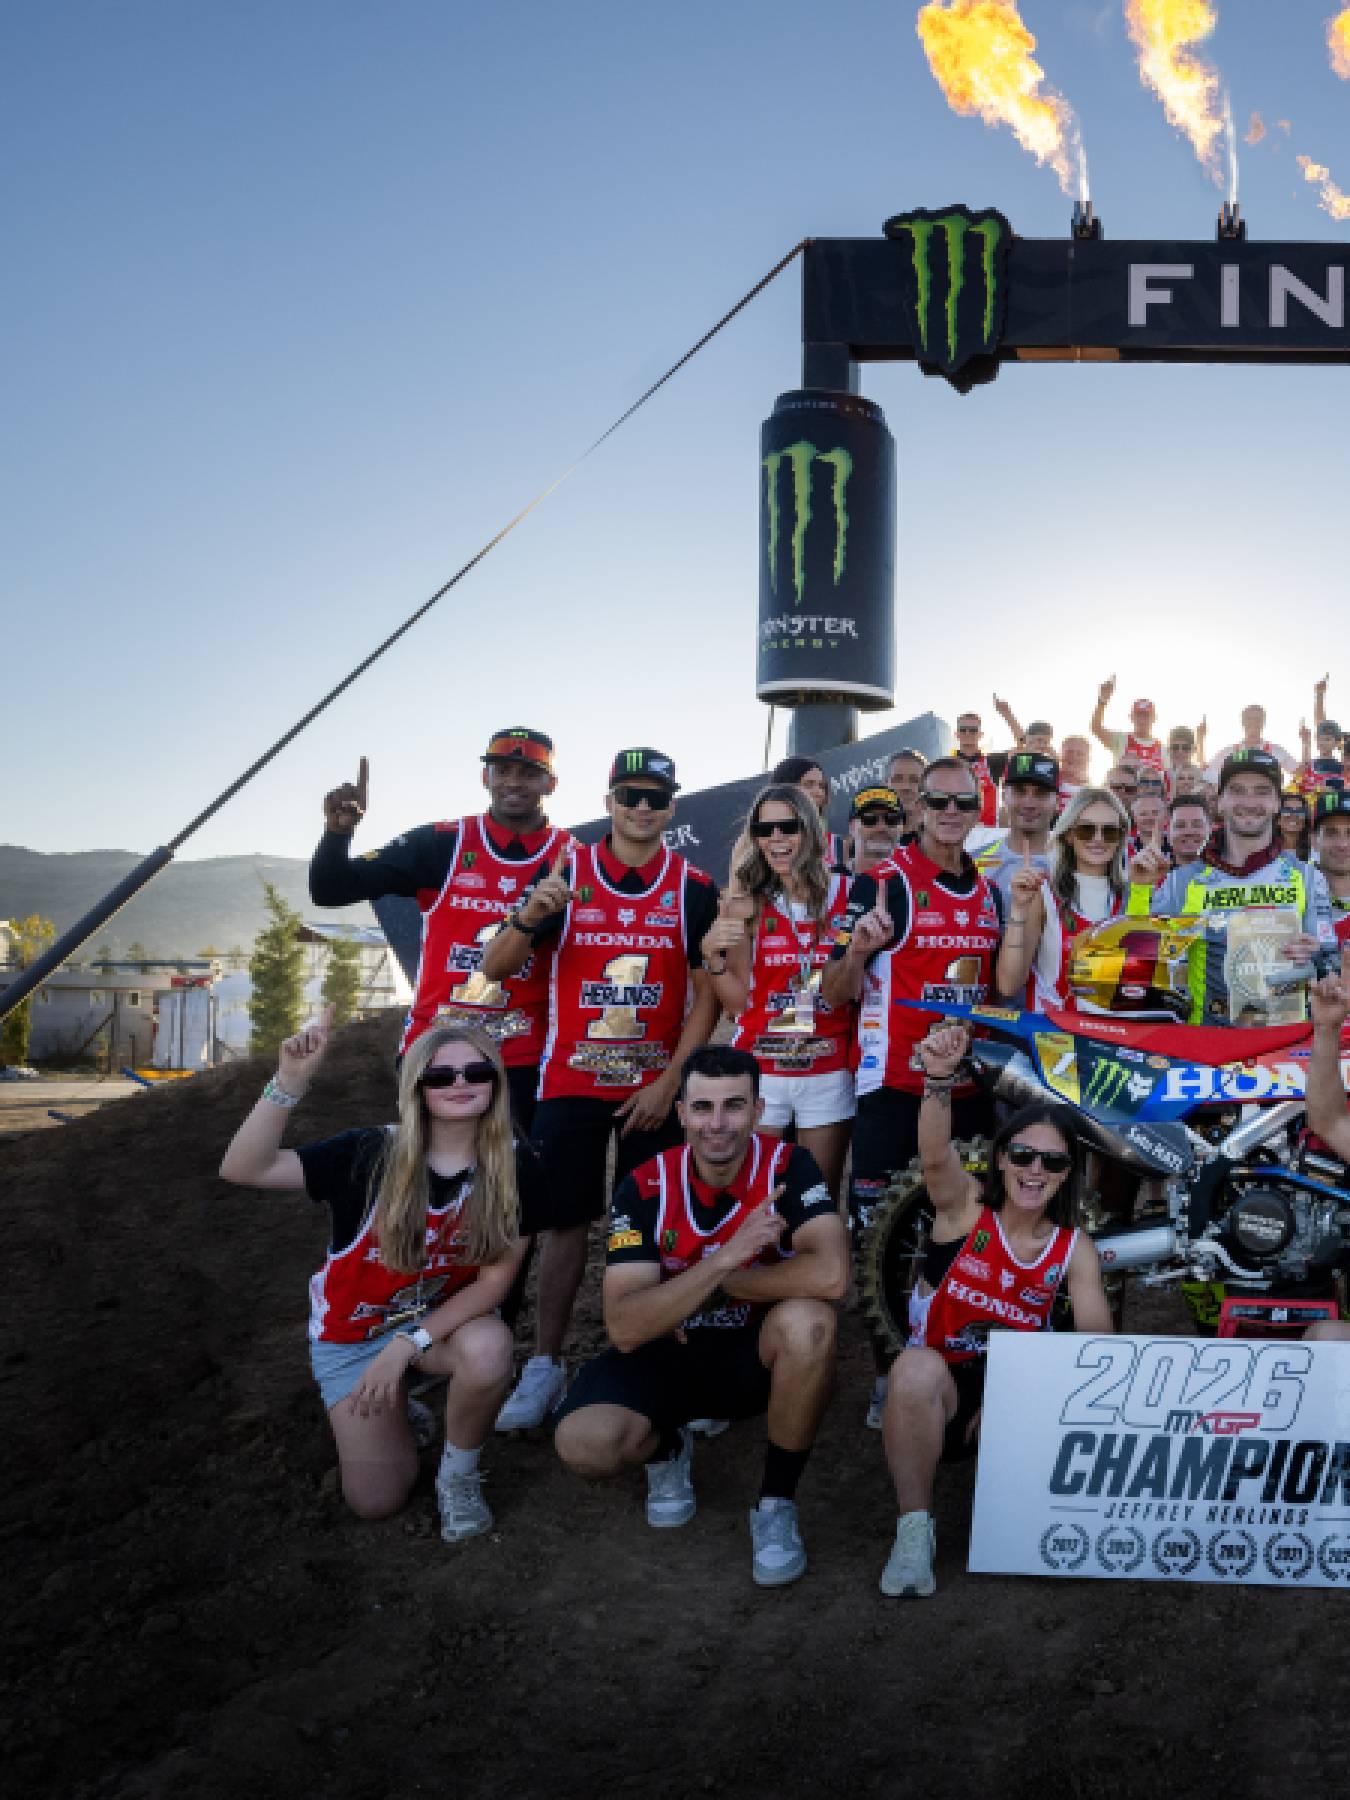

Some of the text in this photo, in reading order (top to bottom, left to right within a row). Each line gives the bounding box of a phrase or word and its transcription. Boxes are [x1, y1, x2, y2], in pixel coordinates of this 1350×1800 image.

[829, 755, 889, 794] MONST
[1202, 885, 1298, 910] HERLINGS
[574, 932, 675, 949] HONDA
[581, 983, 662, 1006] HERLINGS
[947, 1279, 1042, 1327] HONDA
[1058, 1337, 1314, 1432] 2026
[1163, 1409, 1262, 1435] MXGP
[1103, 1502, 1309, 1526] JEFFREY HERLINGS
